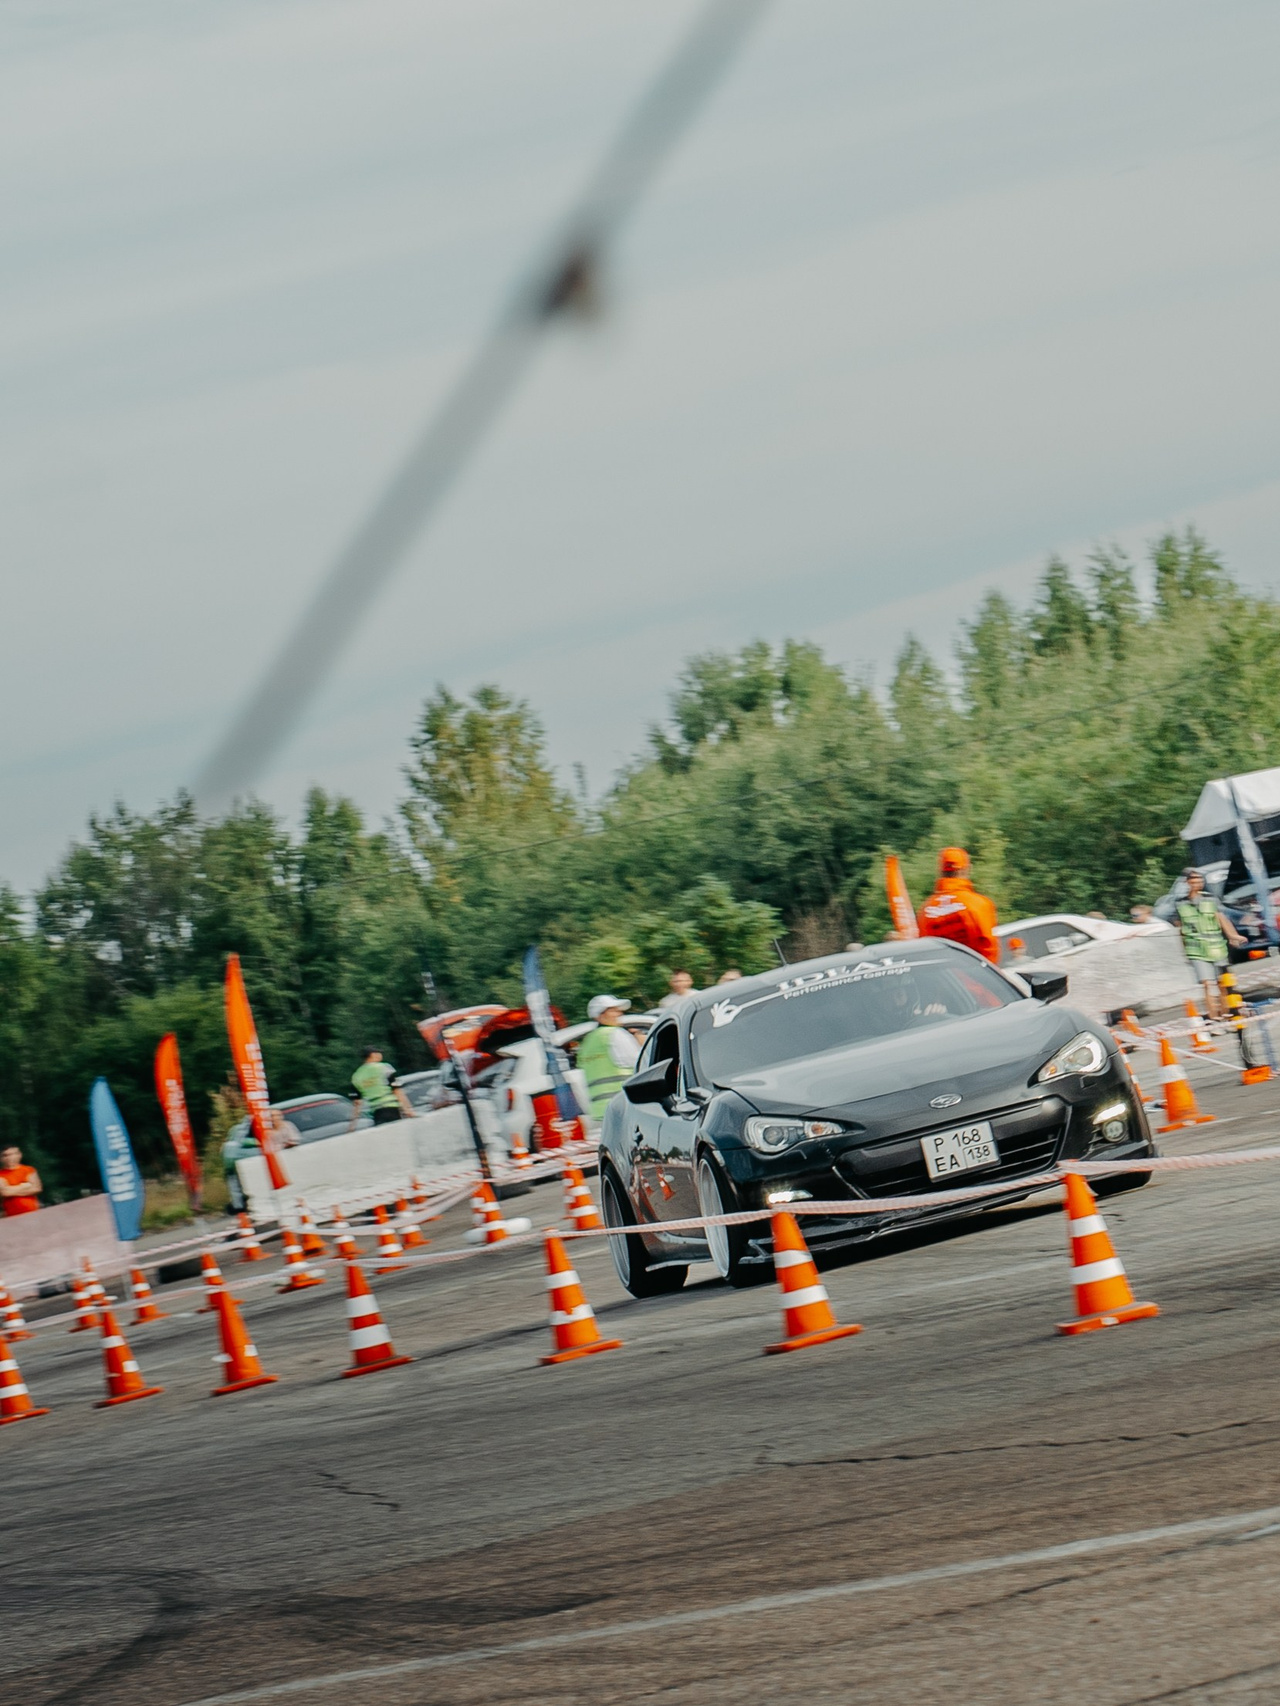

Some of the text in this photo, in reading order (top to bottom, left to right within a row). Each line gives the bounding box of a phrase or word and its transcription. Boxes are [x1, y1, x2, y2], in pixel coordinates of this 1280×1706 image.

[776, 956, 907, 991] IDEAL
[951, 1128, 982, 1148] 168
[967, 1144, 991, 1160] 138
